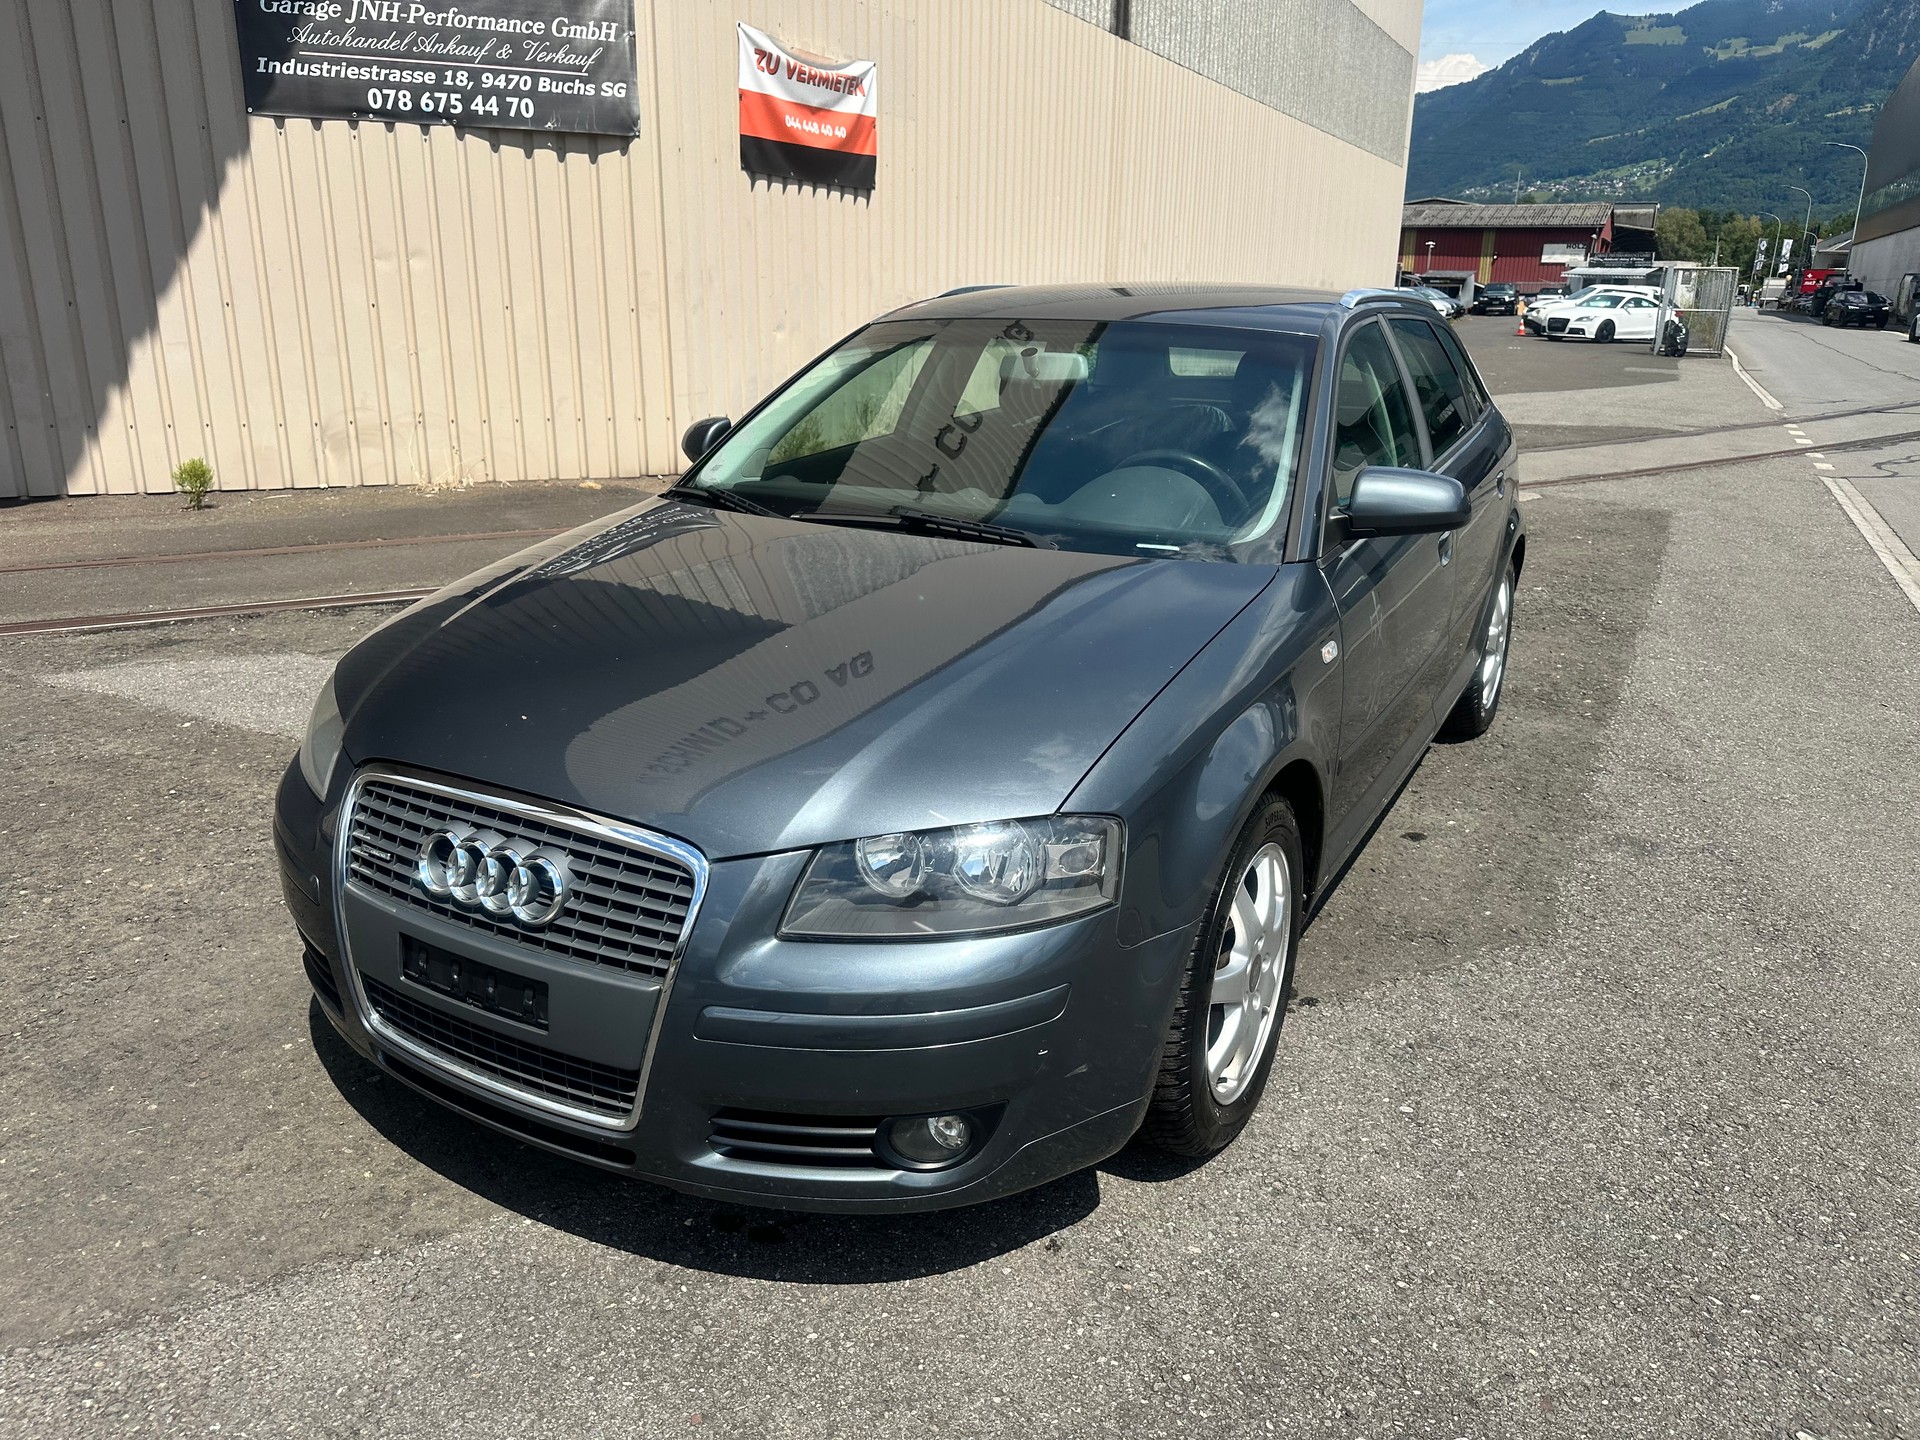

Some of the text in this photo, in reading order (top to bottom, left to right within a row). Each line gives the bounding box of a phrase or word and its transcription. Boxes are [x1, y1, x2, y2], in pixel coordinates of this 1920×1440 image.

[260, 0, 618, 42] Garage JNH-Performance GmbH
[287, 23, 603, 72] Autohandel Ankauf & Verkauf
[257, 57, 627, 98] Industriestrasse 18, 9470 Buchs SG
[754, 48, 865, 97] ZU VERMIETEN
[368, 88, 535, 118] 078 675 44 70
[785, 115, 847, 138] 044 448 40 40
